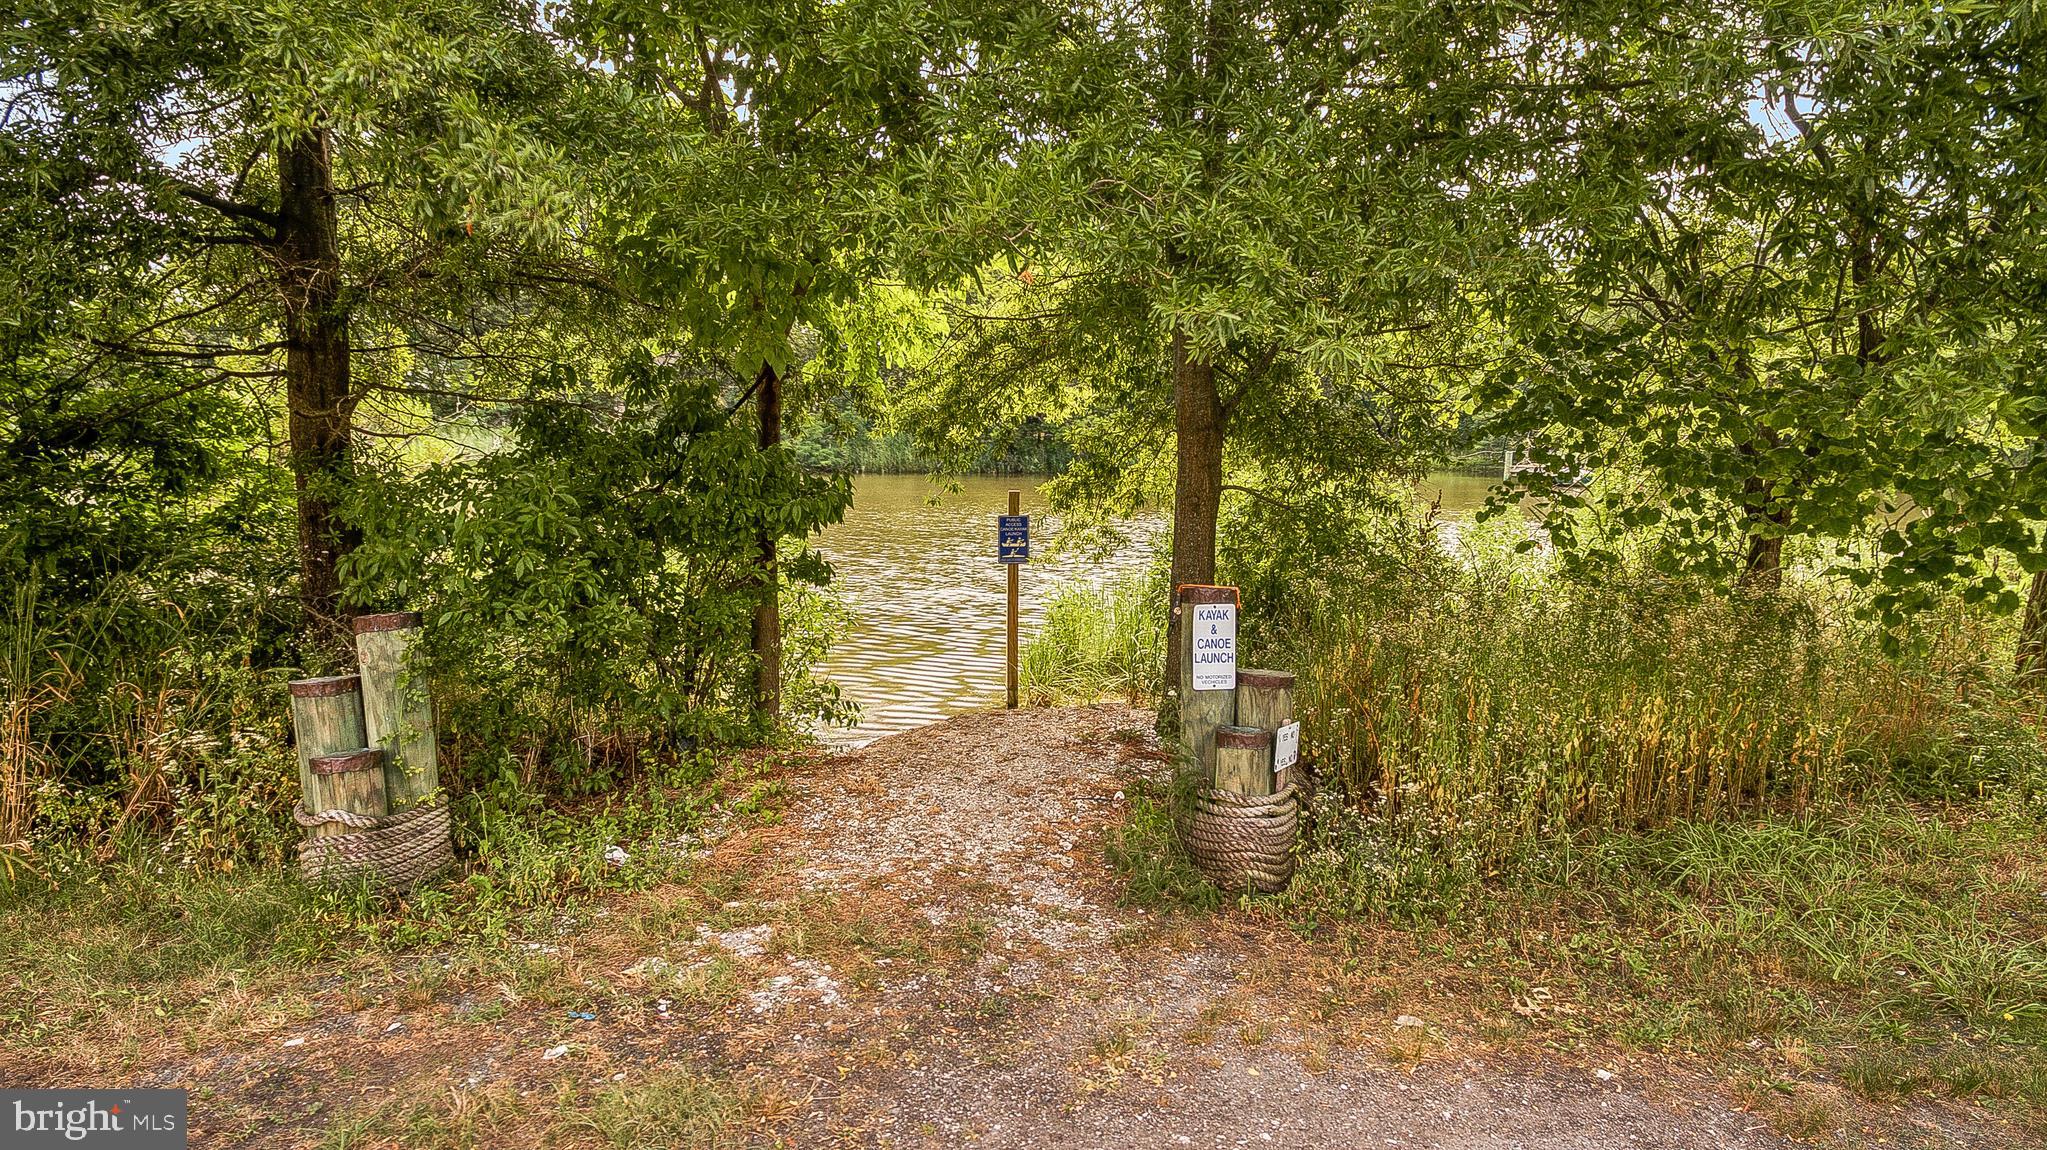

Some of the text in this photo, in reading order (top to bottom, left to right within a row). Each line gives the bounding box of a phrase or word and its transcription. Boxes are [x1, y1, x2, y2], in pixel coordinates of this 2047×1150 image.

[1198, 609, 1230, 621] KAYAK
[1210, 623, 1218, 635] &
[1197, 638, 1232, 650] CANOE
[1194, 652, 1234, 664] LAUNCH
